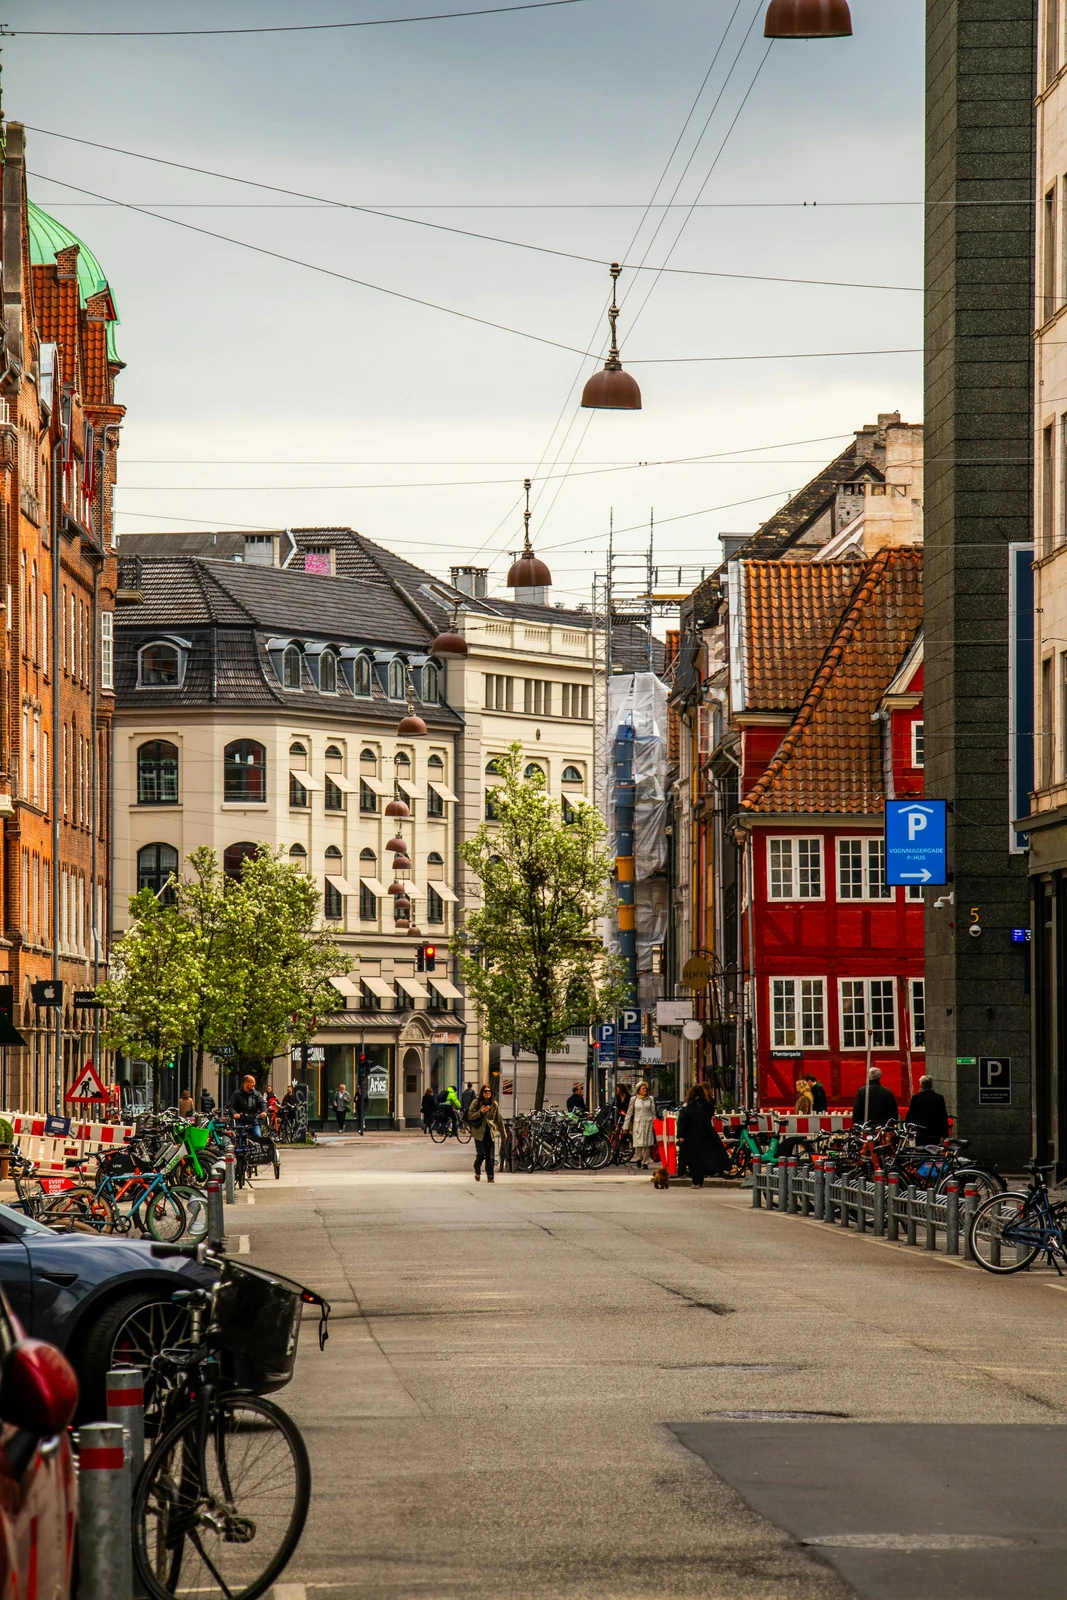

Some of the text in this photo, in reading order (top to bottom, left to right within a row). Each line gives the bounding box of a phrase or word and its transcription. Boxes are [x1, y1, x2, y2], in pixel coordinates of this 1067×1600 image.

[908, 812, 928, 841] P
[970, 907, 980, 923] 5
[623, 1011, 638, 1030] P
[602, 1025, 613, 1040] P
[987, 1060, 1003, 1085] P
[370, 1077, 387, 1093] Aries
